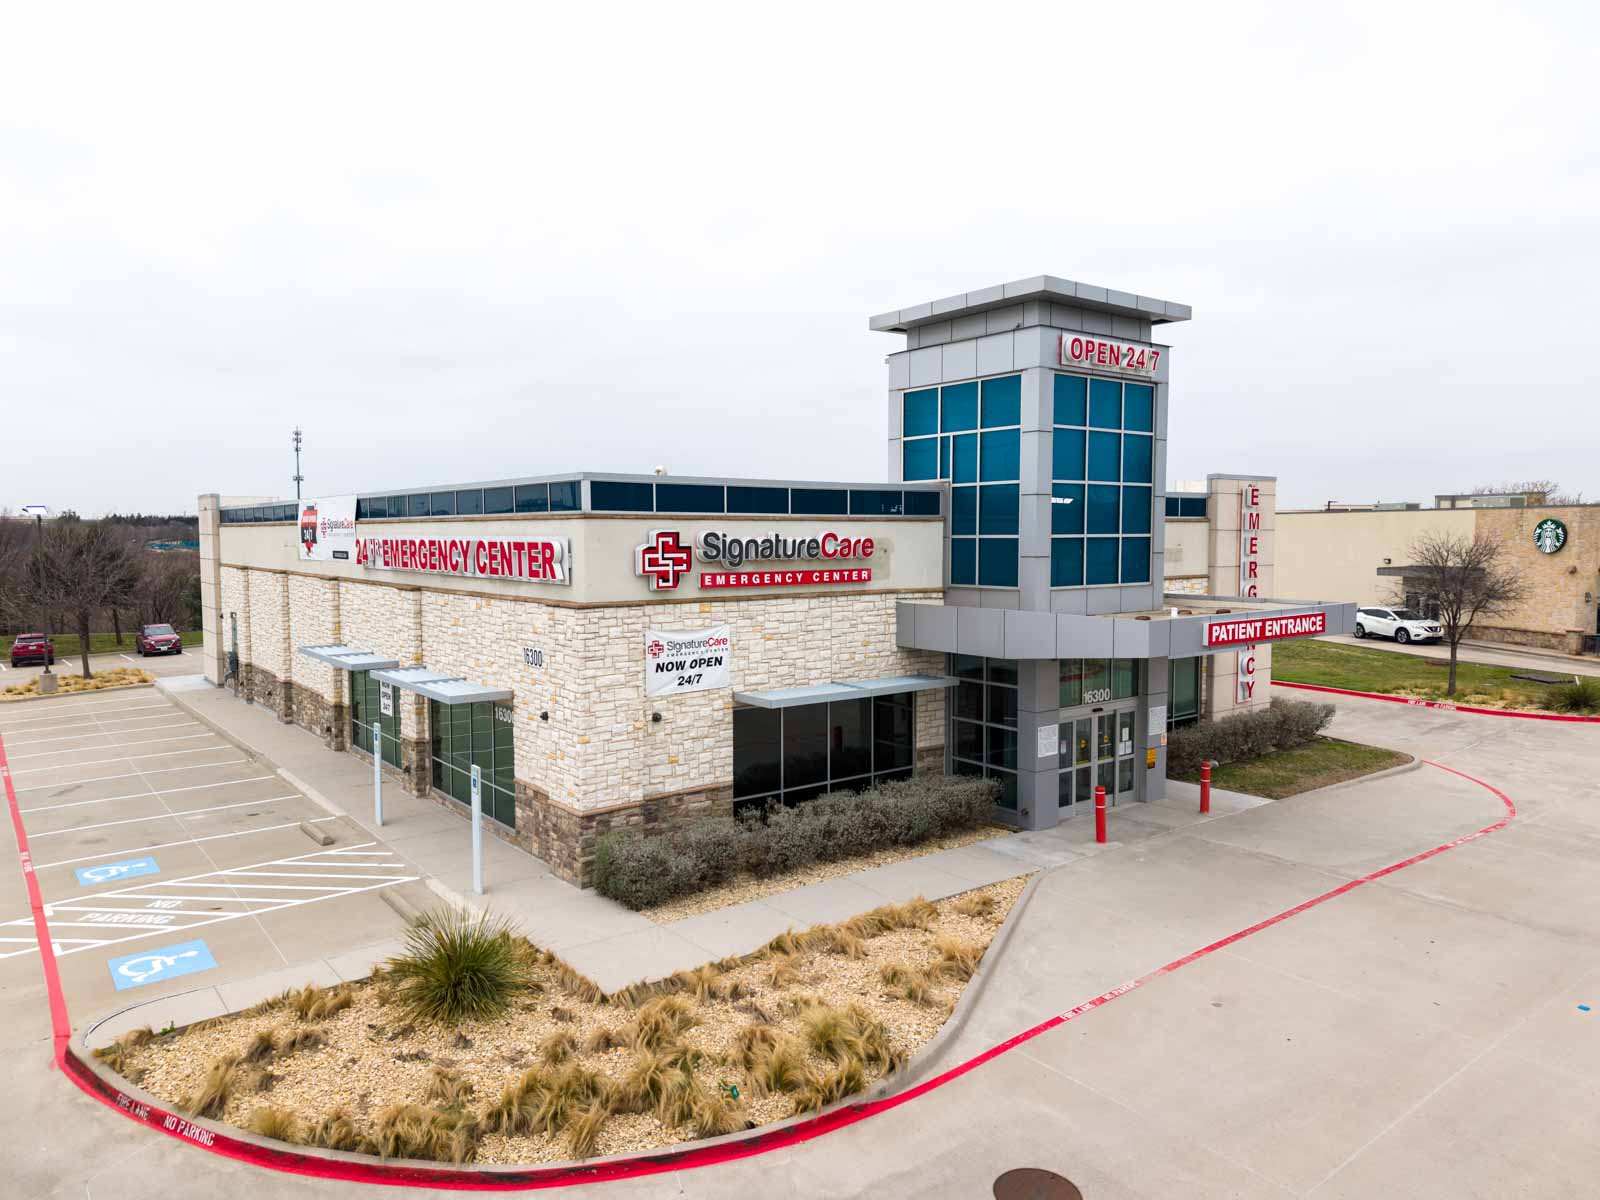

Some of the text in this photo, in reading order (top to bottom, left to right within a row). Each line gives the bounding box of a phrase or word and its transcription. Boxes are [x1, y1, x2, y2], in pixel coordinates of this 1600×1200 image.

[1070, 337, 1120, 366] OPEN
[702, 532, 874, 567] SignatureCare
[355, 538, 368, 564] 24
[382, 538, 470, 573] EMERGENCY
[474, 540, 557, 580] CENTER
[704, 571, 869, 585] EMERGENCY CENTER
[1212, 616, 1323, 642] PATIENT ENTRANCE
[666, 637, 728, 652] SignatureCare
[523, 648, 543, 667] 16300
[655, 656, 723, 673] NOW OPEN
[677, 673, 703, 686] 24/7
[1084, 688, 1110, 705] 16300
[79, 912, 175, 924] PARKING
[163, 1114, 177, 1130] NO
[177, 1120, 215, 1147] PARKING
